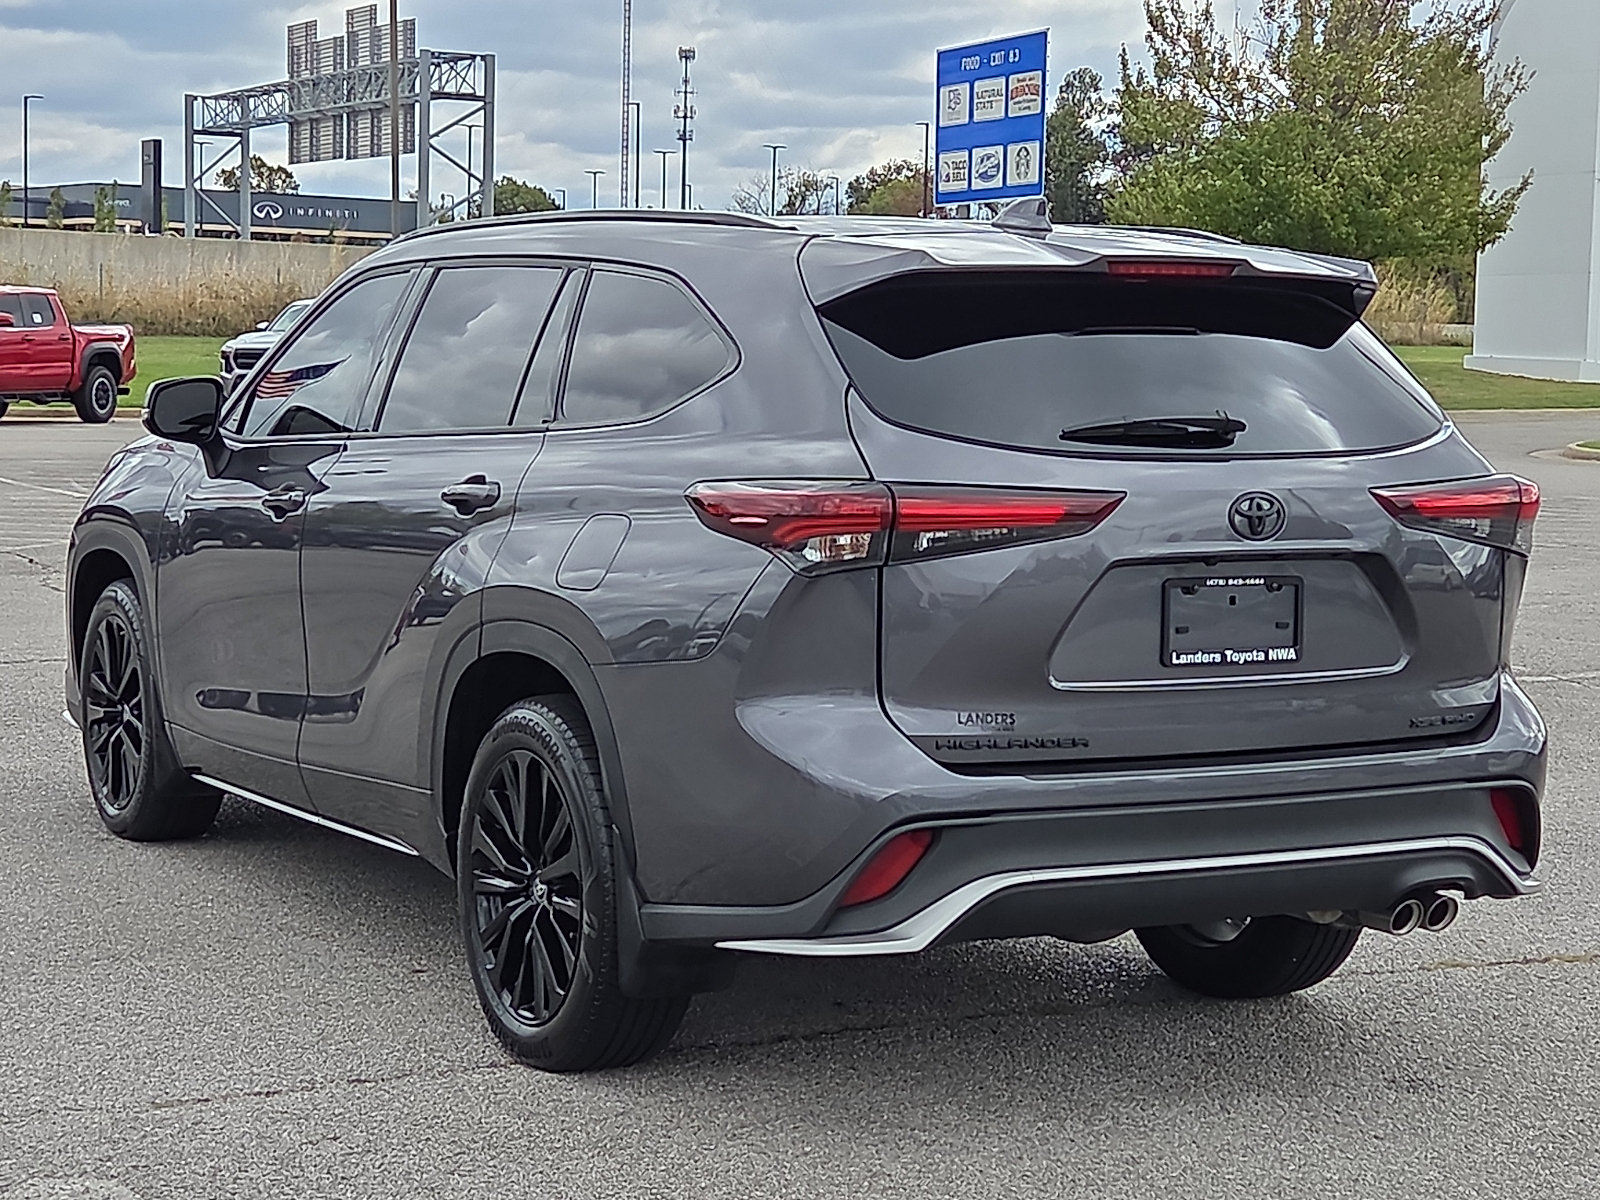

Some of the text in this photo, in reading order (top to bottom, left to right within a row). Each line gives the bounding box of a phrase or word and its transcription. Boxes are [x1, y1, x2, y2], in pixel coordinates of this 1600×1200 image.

[961, 55, 981, 71] FOOD
[990, 50, 1006, 67] EXIT
[975, 87, 1004, 100] NATURAL
[975, 100, 994, 112] STATE
[951, 159, 967, 171] TACO
[951, 170, 967, 182] BELL
[289, 206, 359, 220] INFINITI
[1172, 648, 1297, 664] Landers Toyota NWA
[957, 712, 1016, 726] LANDERS
[935, 737, 1090, 751] HIGHLANDER
